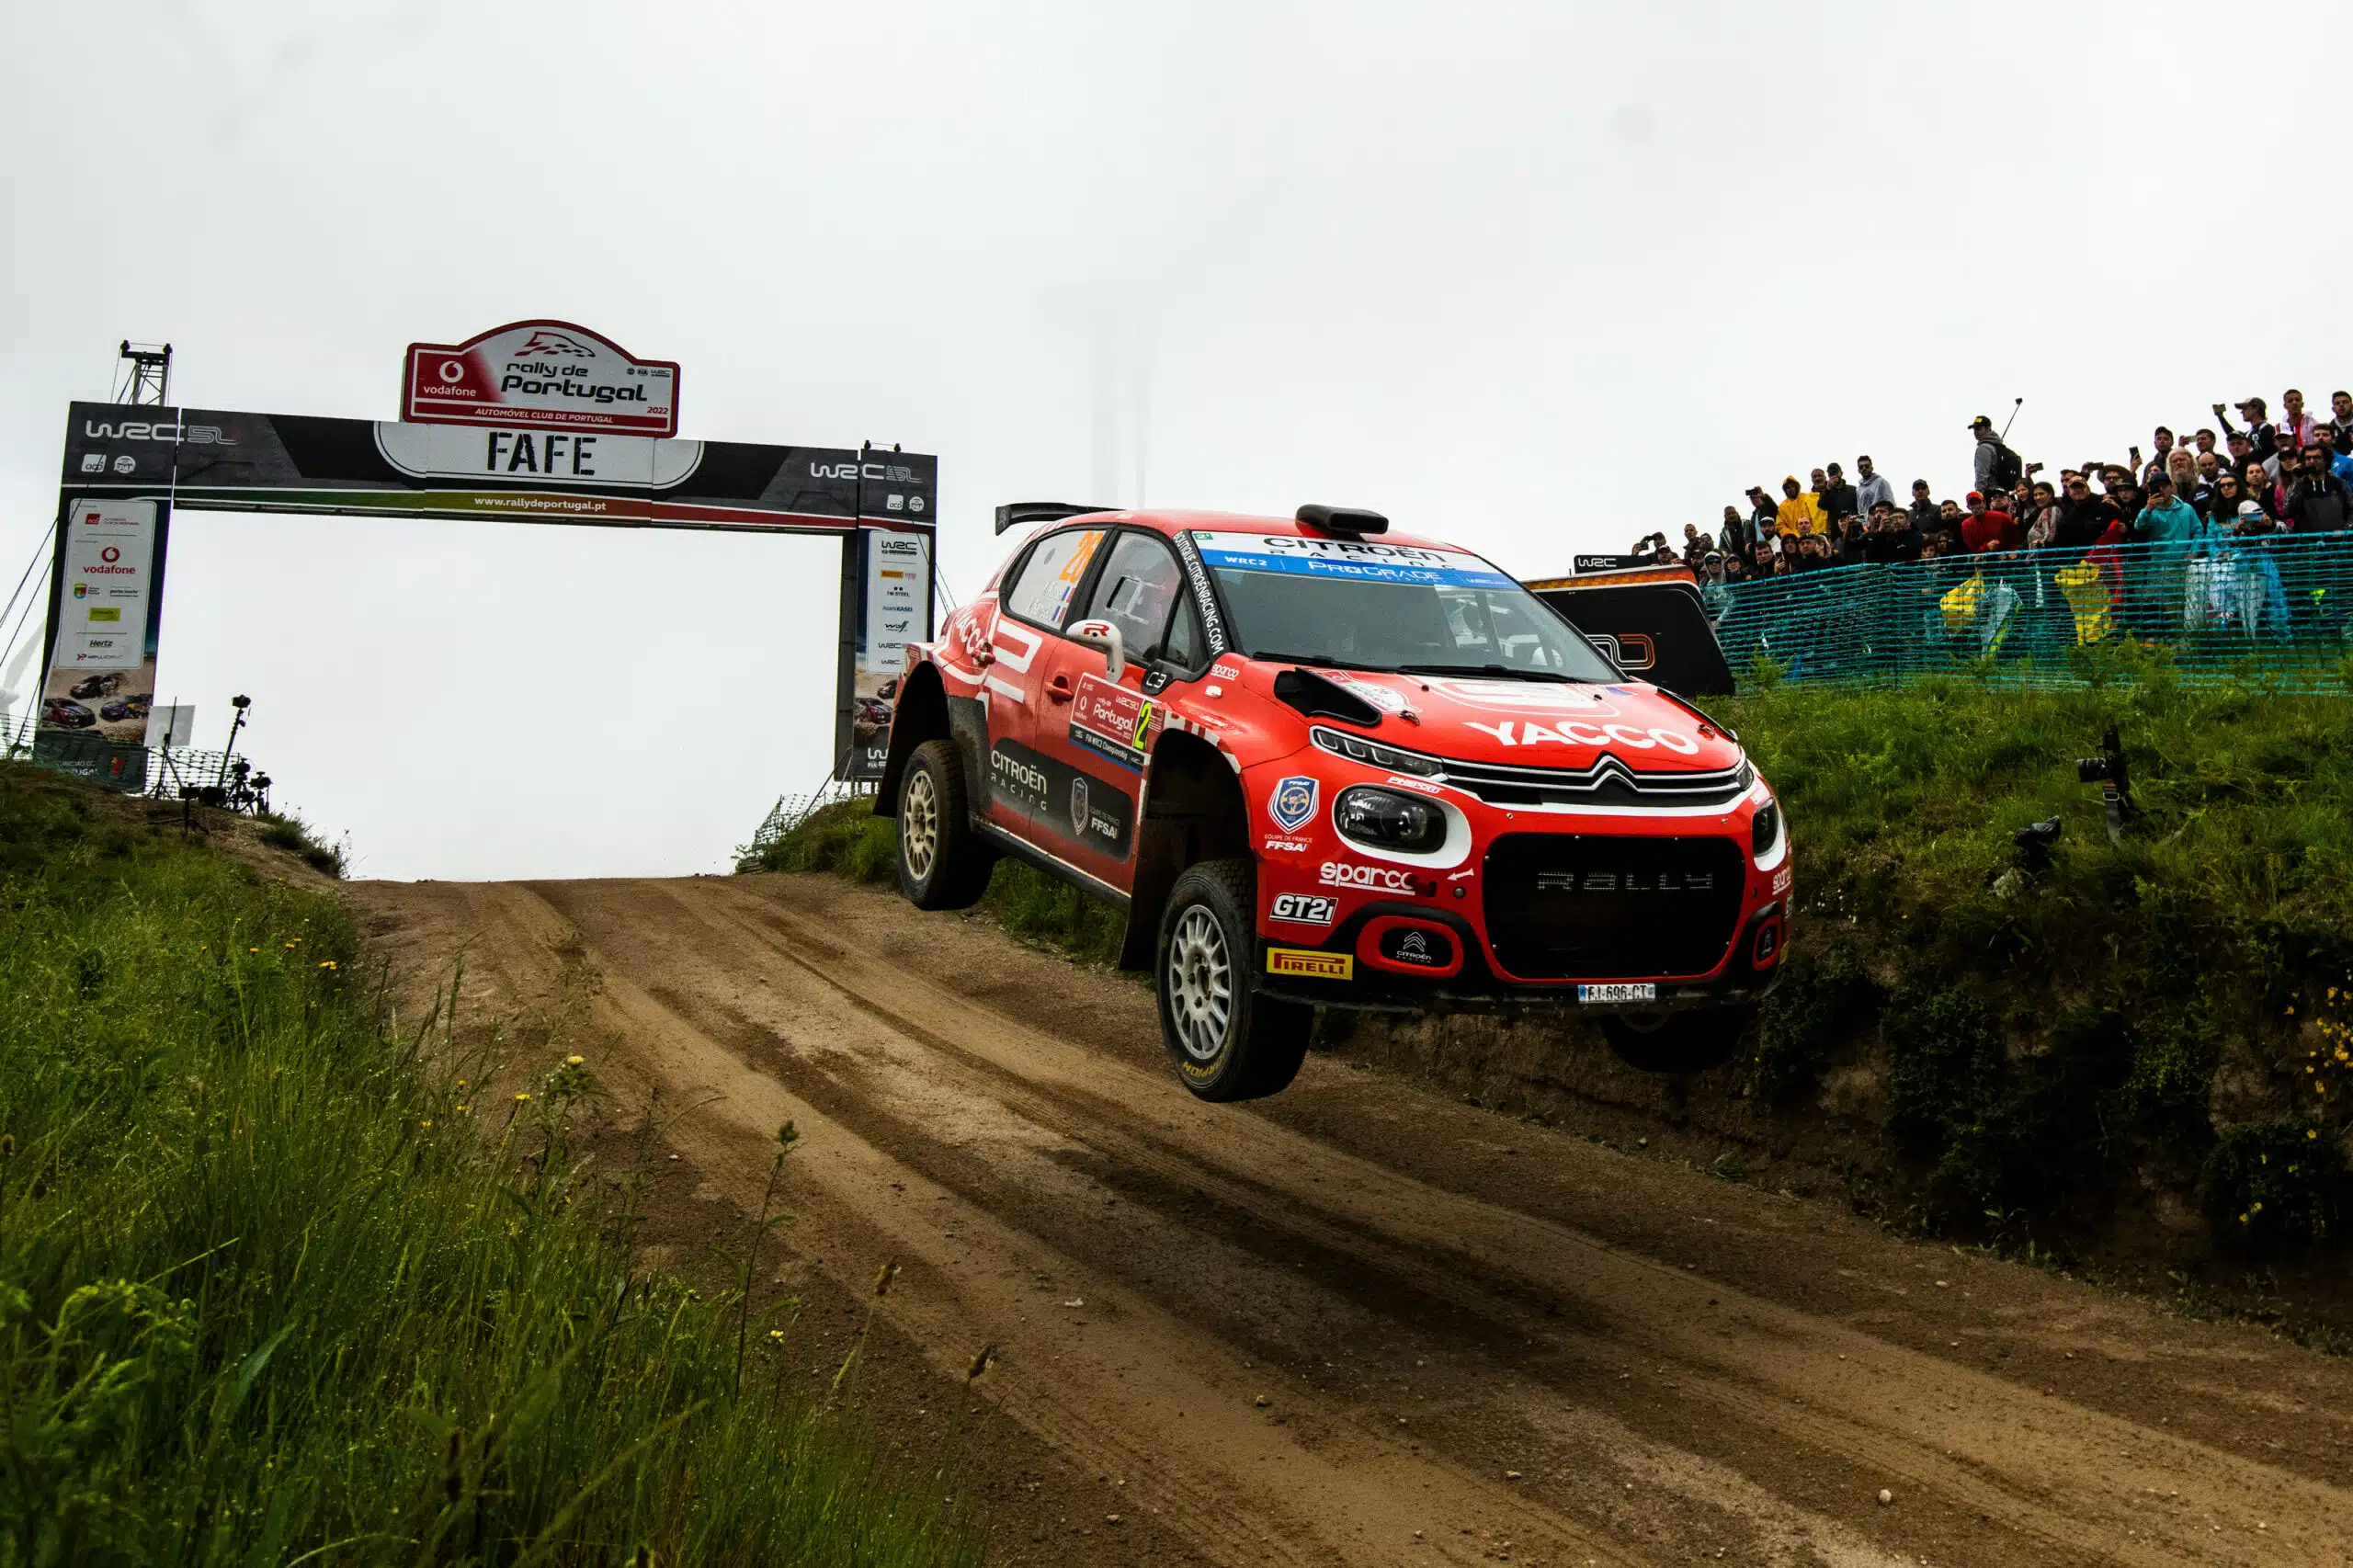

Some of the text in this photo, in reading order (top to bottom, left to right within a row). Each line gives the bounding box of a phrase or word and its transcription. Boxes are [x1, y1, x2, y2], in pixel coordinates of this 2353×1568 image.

[506, 361, 588, 379] rally de
[423, 384, 477, 397] vodafone
[500, 375, 648, 403] Portugal
[474, 408, 529, 419] AUTOMÓVEL
[531, 412, 553, 420] CLUB
[568, 414, 614, 424] PORTUGAL
[646, 406, 669, 415] 2022
[487, 431, 597, 475] FAFE
[474, 497, 607, 511] www.rallydeportugal.pt
[1059, 530, 1104, 584] 26
[1224, 555, 1267, 566] WRC2
[1263, 537, 1447, 562] CITROËN
[1269, 550, 1456, 571] RACING
[83, 565, 136, 574] vodafone
[1578, 557, 1617, 568] WRC
[1173, 530, 1224, 655] BOUTIQUE.CITROËNRACING.COM
[1145, 671, 1167, 688] C3
[1211, 663, 1240, 679] sparco
[1093, 703, 1133, 731] Portugal
[1462, 721, 1699, 756] YACCO
[991, 750, 1047, 794] CITROËN
[990, 773, 1047, 811] RACING
[1272, 893, 1338, 922] GT2i
[1274, 952, 1346, 975] PIRELLI
